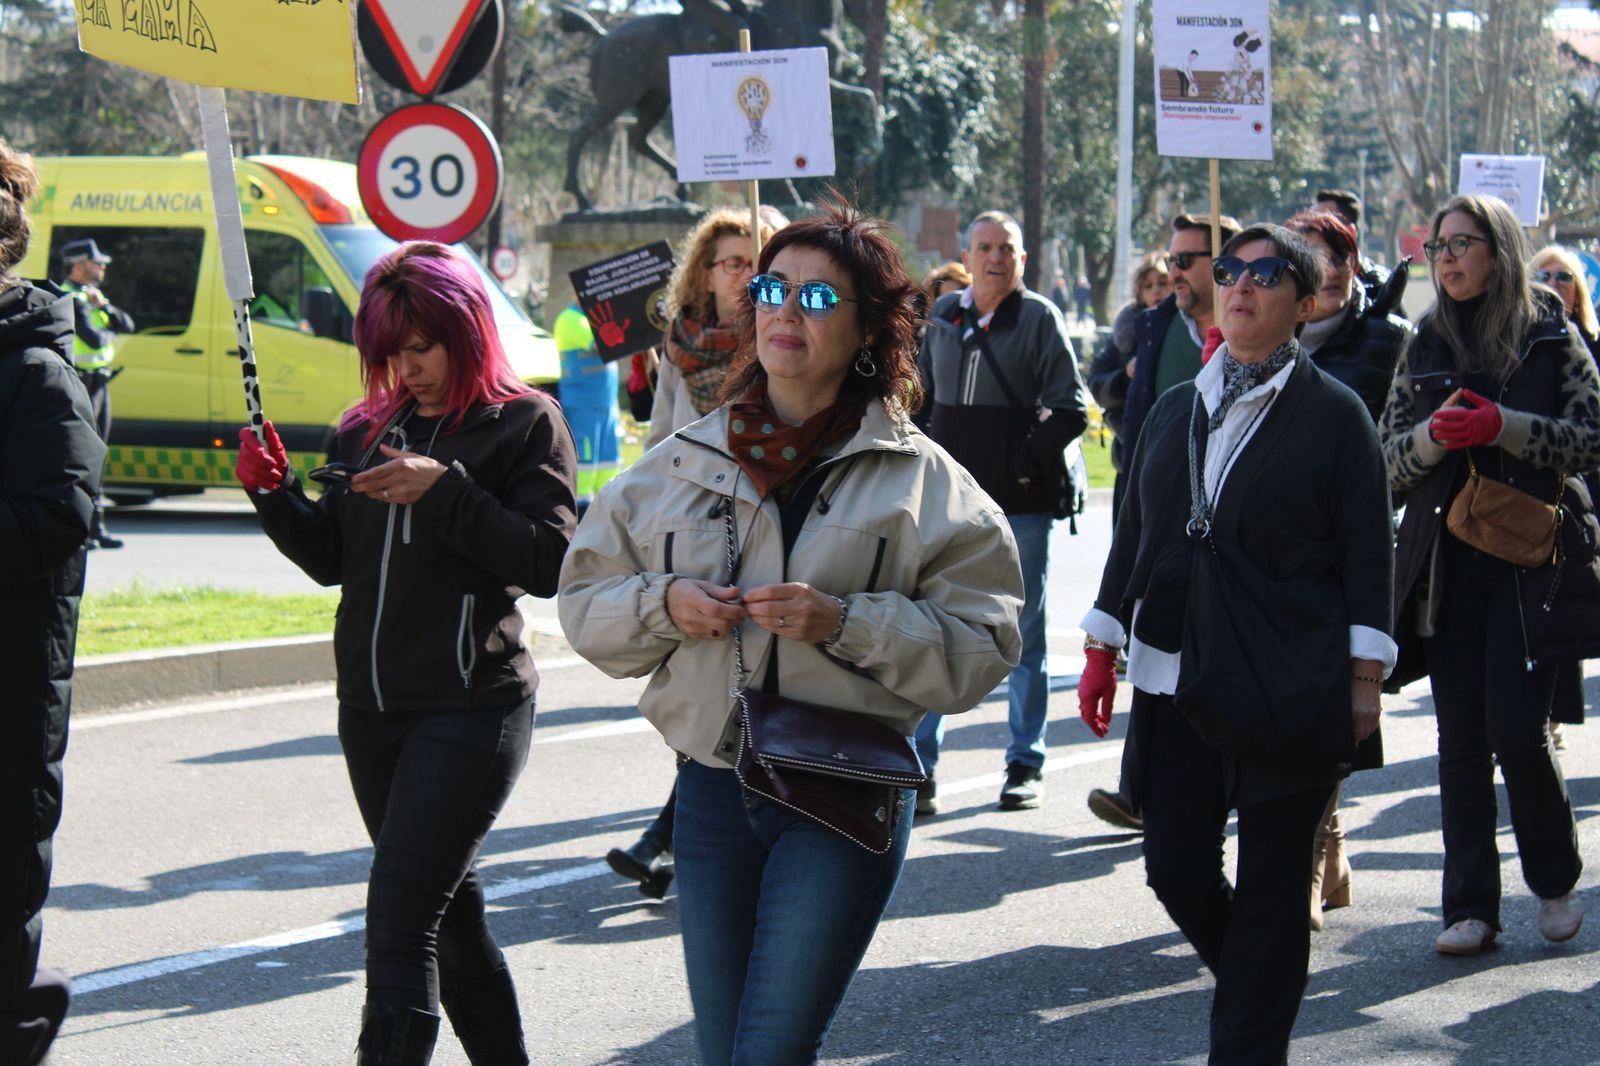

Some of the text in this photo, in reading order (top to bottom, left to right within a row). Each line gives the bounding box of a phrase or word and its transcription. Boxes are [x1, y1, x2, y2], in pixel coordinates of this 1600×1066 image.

[1176, 15, 1228, 27] MANIFESTACIÓN
[1161, 103, 1235, 115] Sembrando futuro
[390, 154, 464, 199] 30
[71, 193, 203, 212] AMBULANCIA
